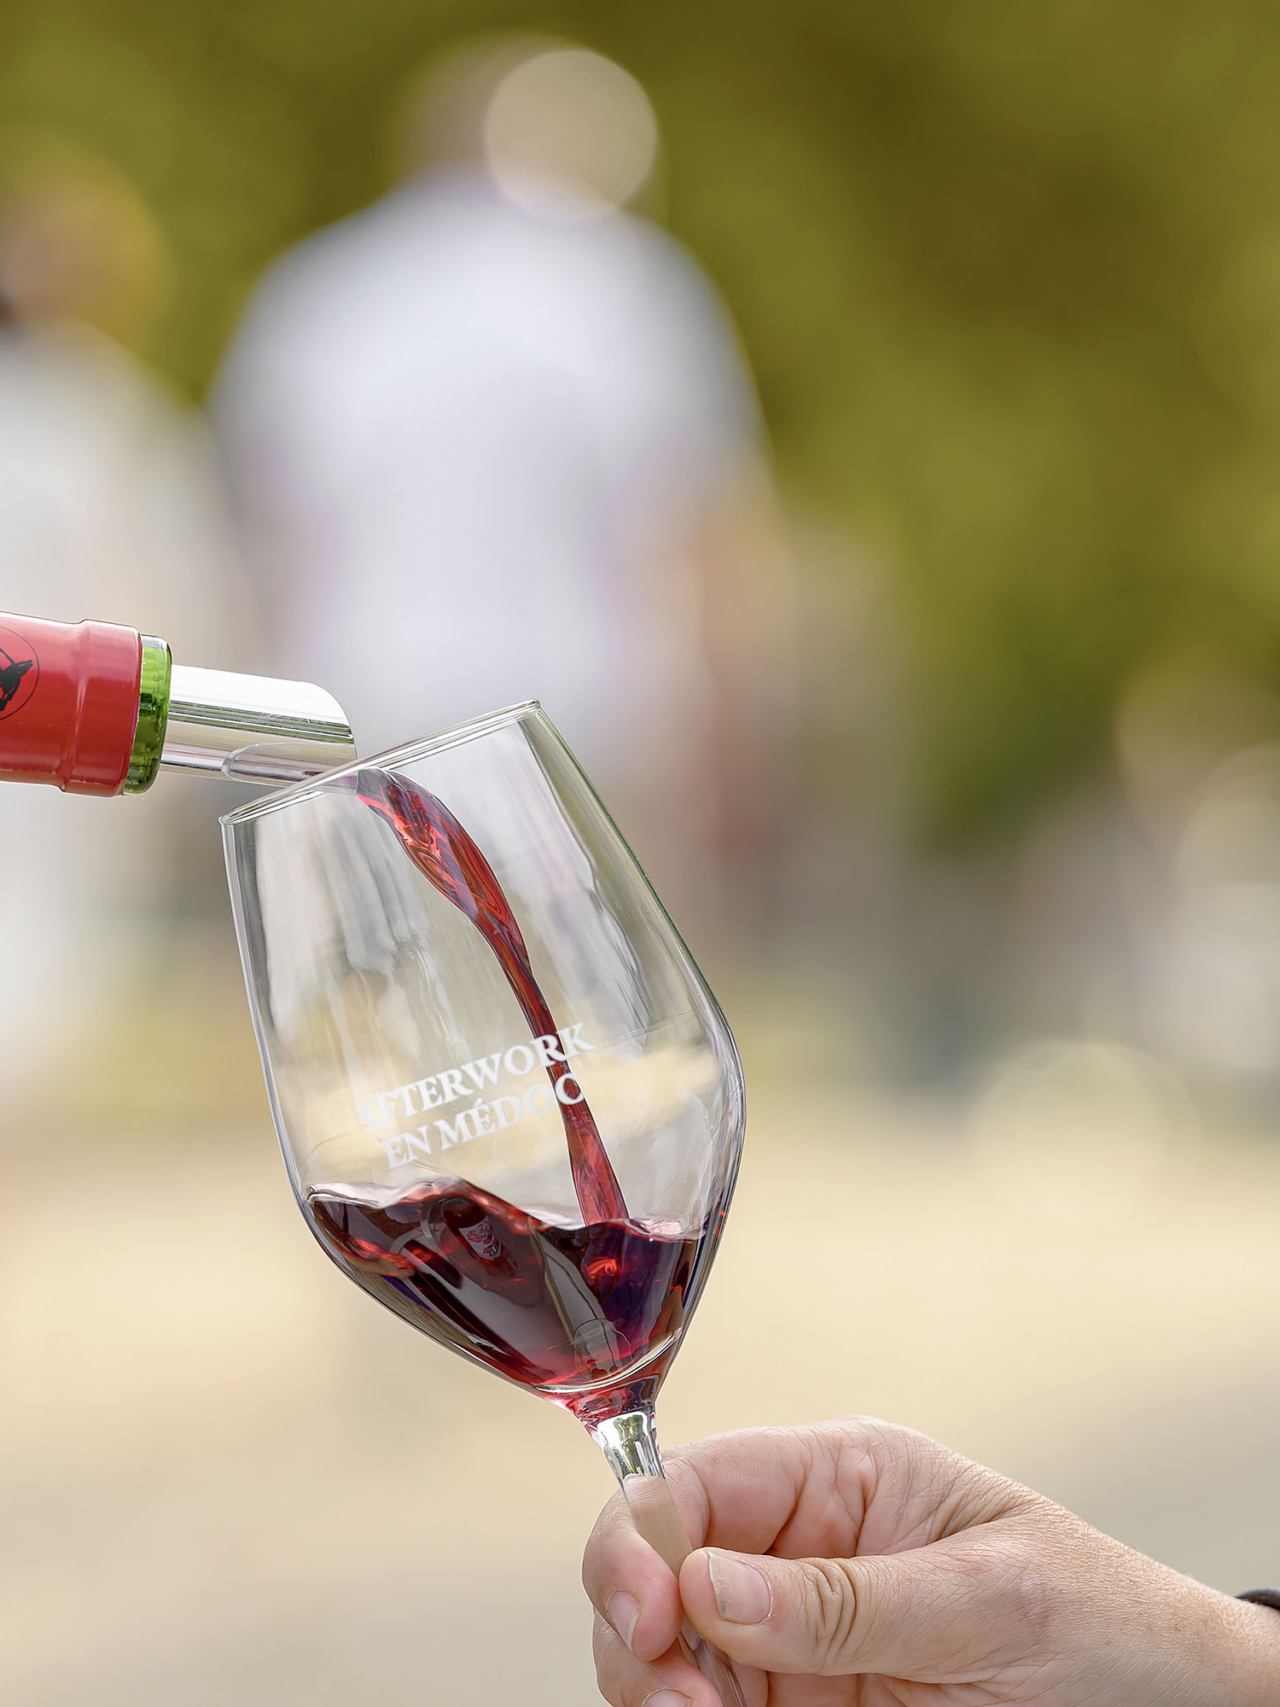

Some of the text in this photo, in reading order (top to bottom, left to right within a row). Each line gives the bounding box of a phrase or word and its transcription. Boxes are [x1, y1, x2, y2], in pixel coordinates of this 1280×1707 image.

[358, 1022, 595, 1130] AFTERWORK
[380, 1071, 586, 1169] EN MÉDOC
